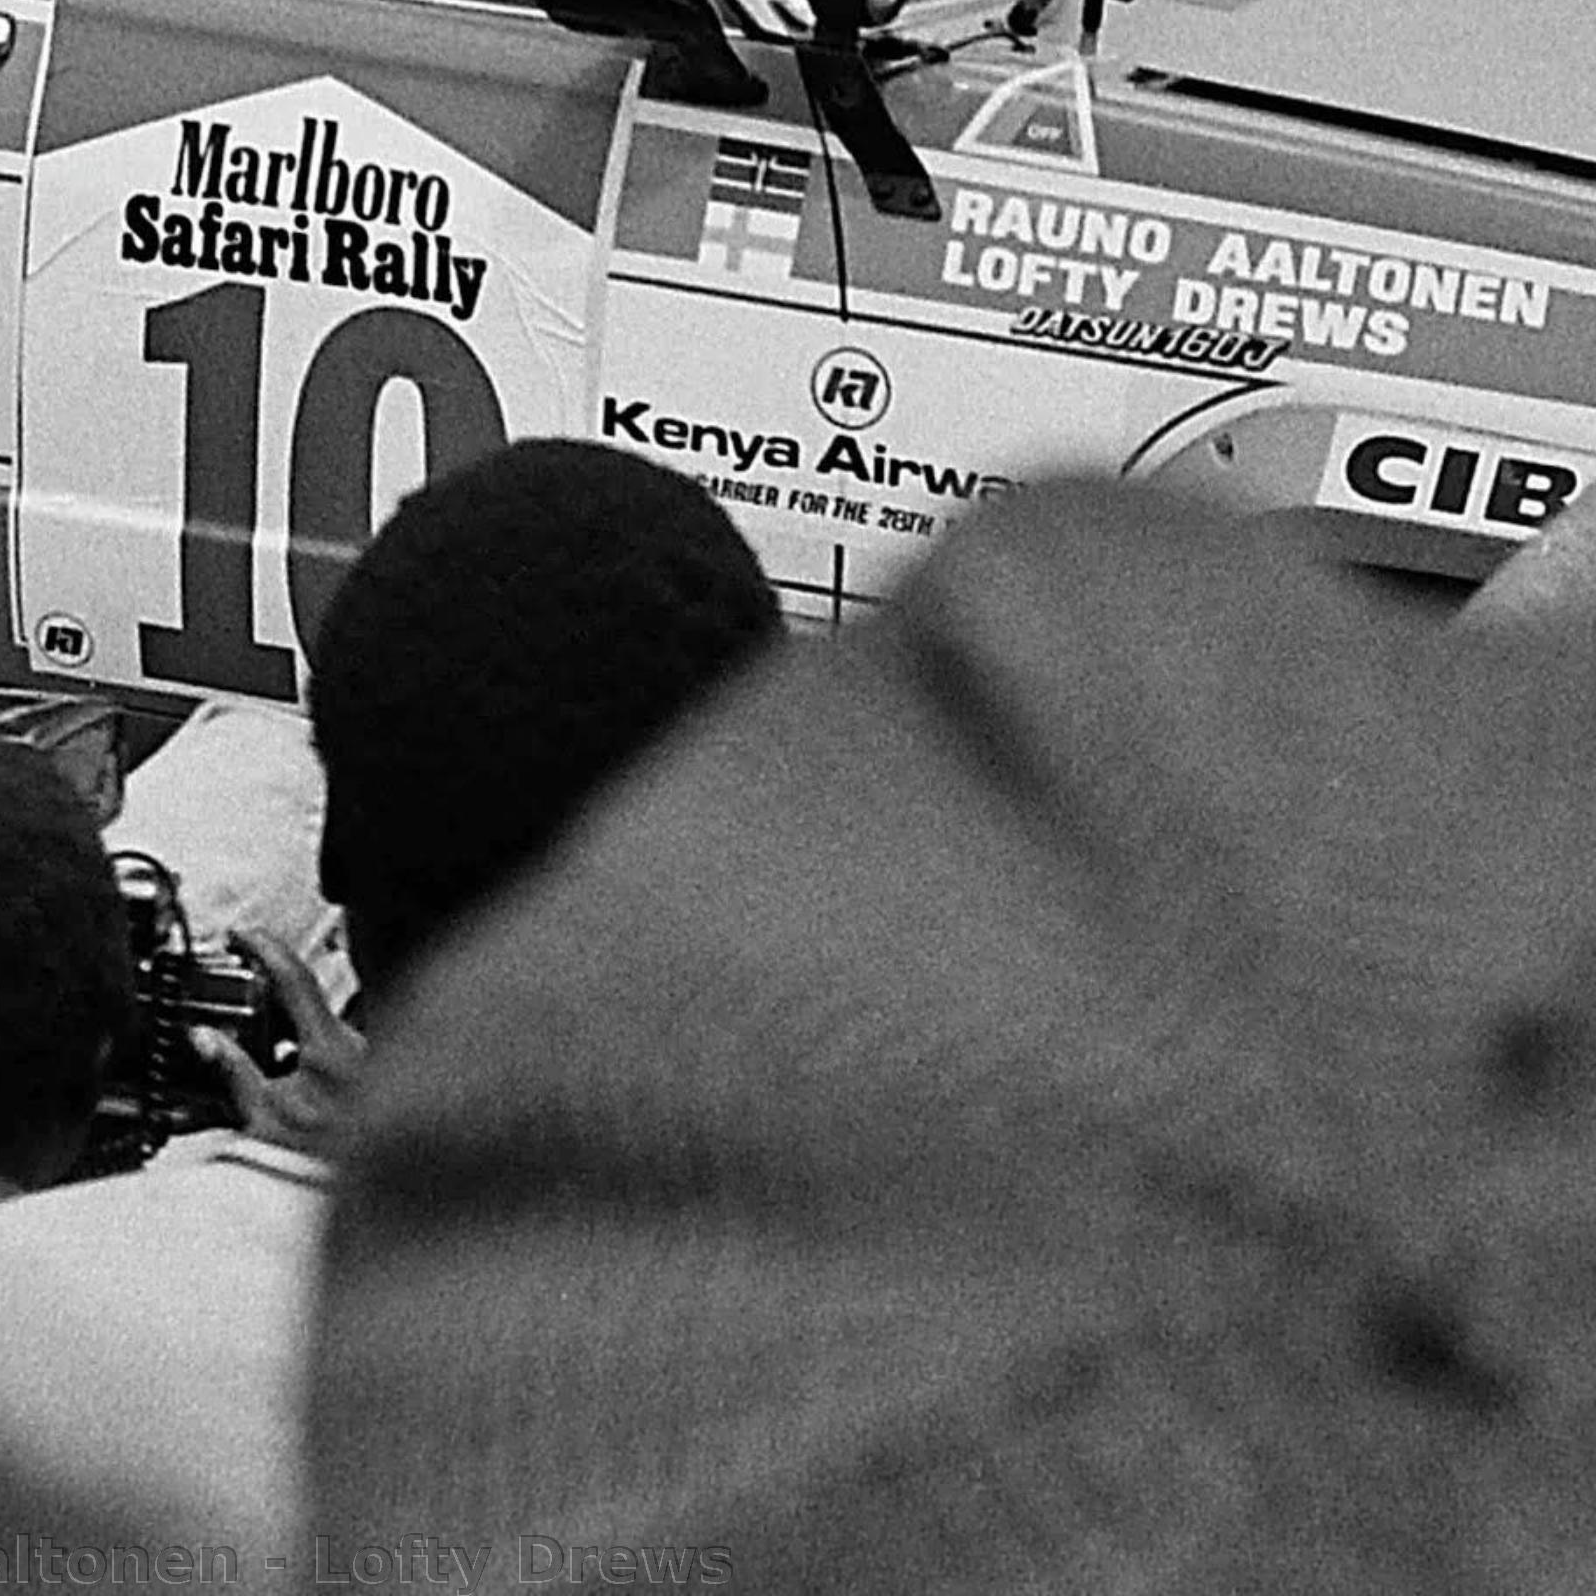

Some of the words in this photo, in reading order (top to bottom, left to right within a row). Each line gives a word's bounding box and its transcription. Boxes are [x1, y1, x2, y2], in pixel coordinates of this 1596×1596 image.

[170, 116, 450, 232] Marlboro
[119, 193, 310, 283] Safari
[321, 218, 487, 321] Rally
[941, 240, 1142, 311] LOFTY
[1171, 277, 1410, 357] DREWS
[951, 188, 1173, 264] RAUNO
[1207, 231, 1550, 329] AALTONEN
[601, 397, 800, 472] Kenya
[815, 433, 1025, 501] Airwa
[788, 487, 827, 517] FOR
[830, 495, 871, 527] THE
